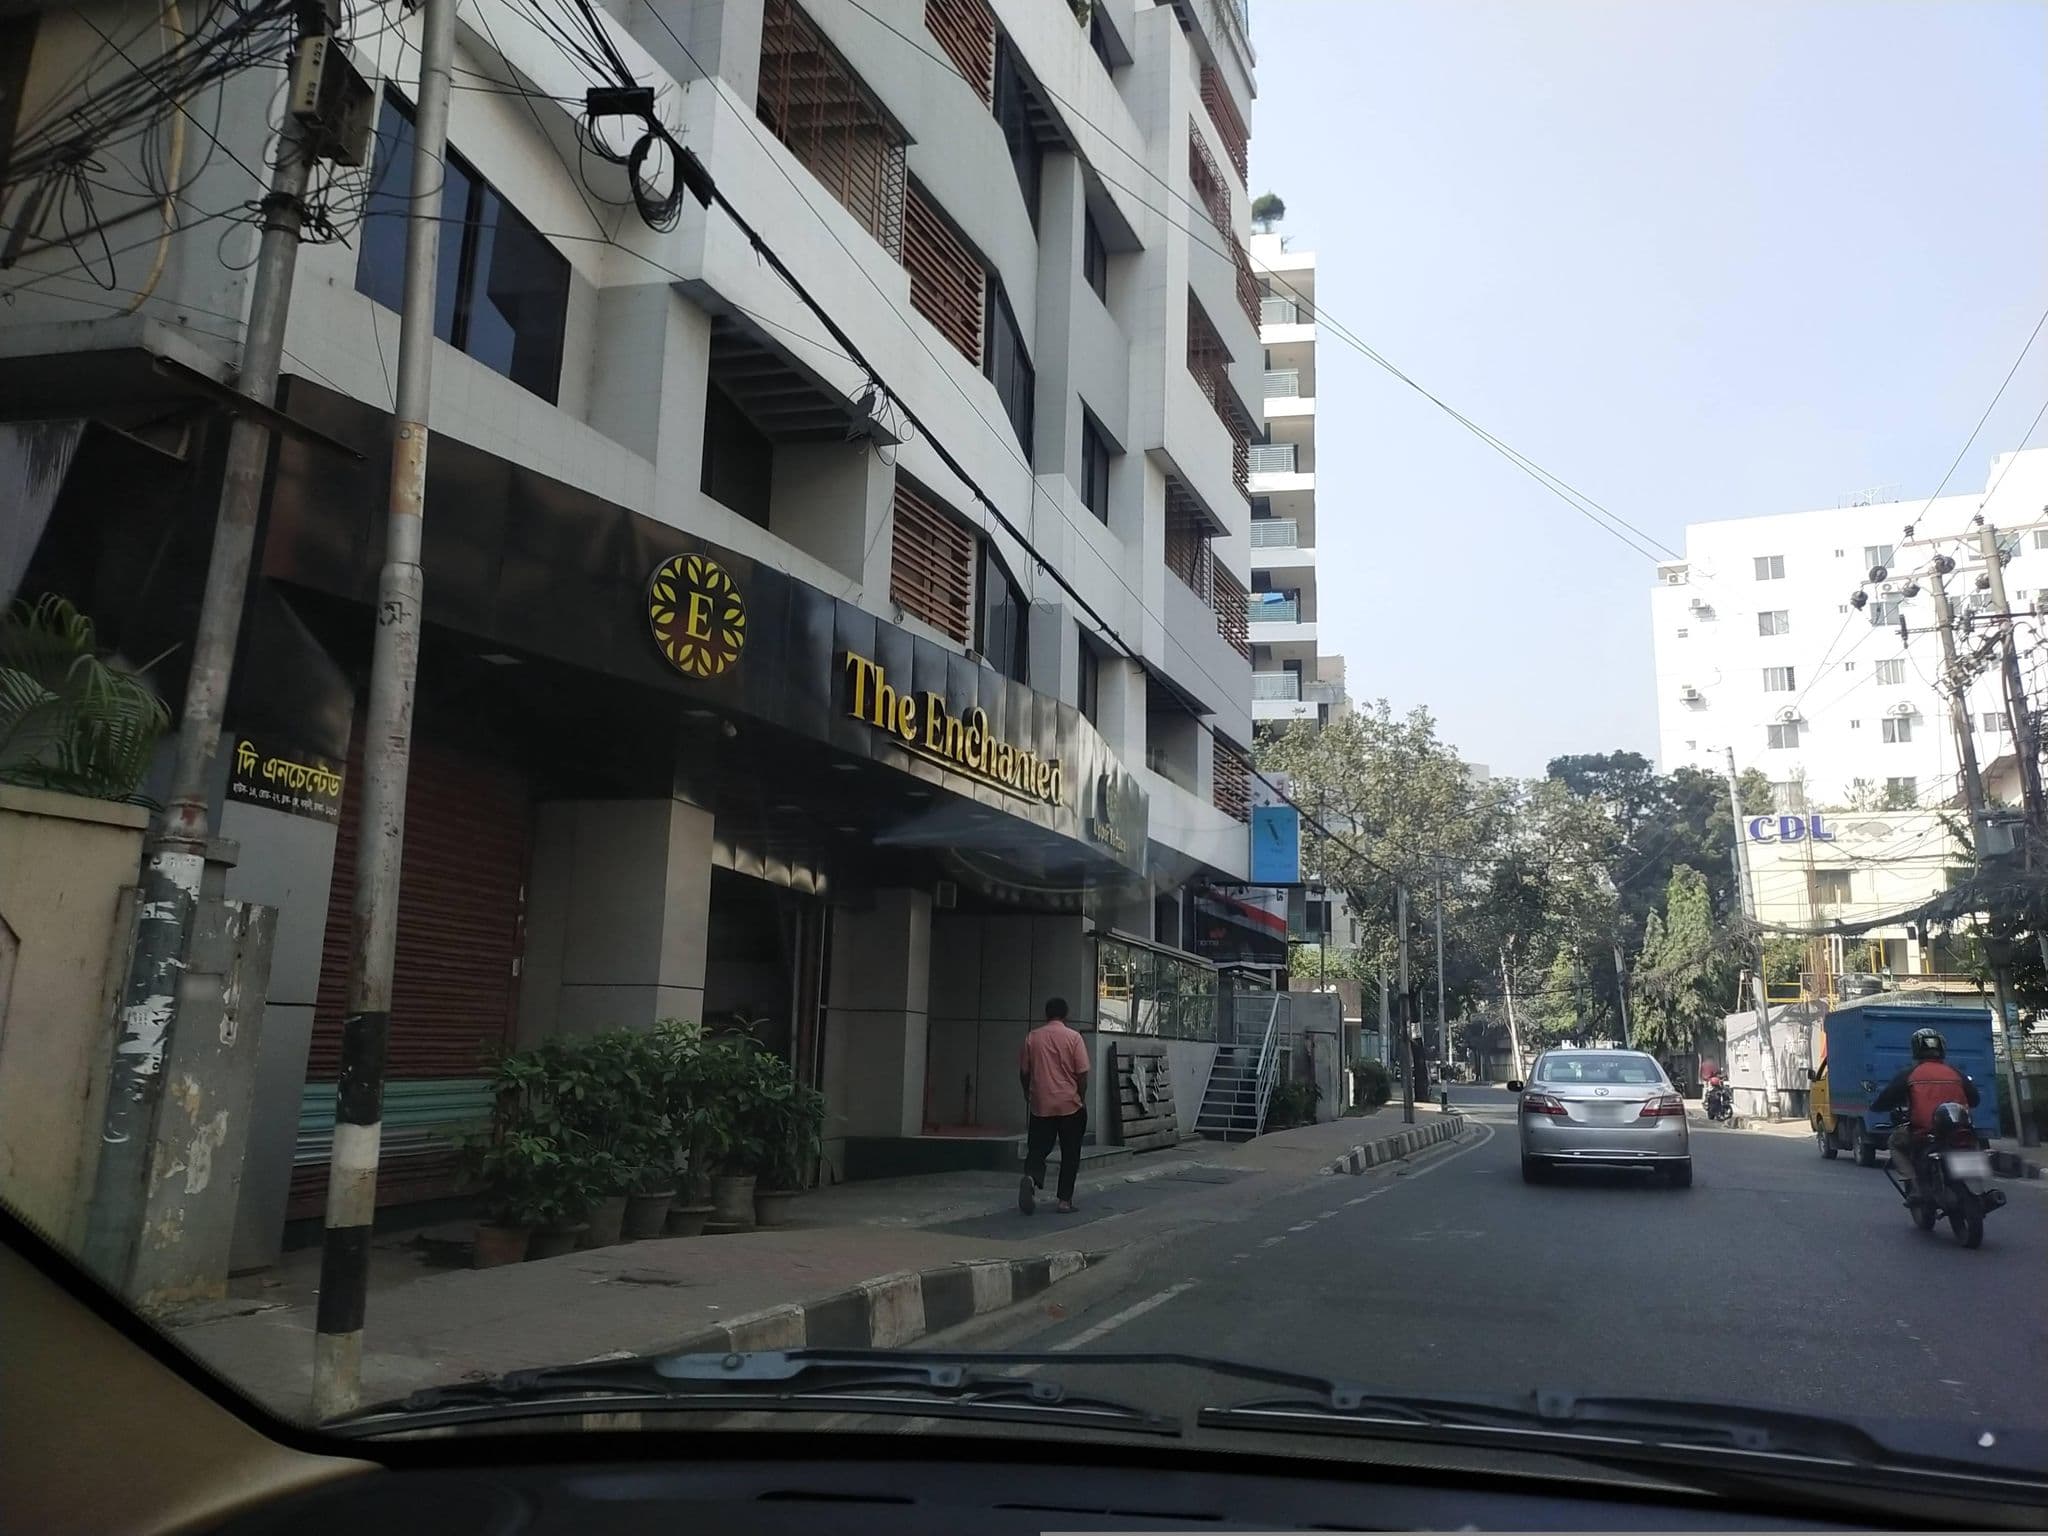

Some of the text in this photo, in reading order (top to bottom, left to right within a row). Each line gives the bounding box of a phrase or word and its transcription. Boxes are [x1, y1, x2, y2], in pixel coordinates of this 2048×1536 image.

[686, 591, 714, 641] E
[846, 651, 1064, 806] The Enchanted
[237, 740, 260, 778] দি
[1749, 815, 1836, 843] CDL
